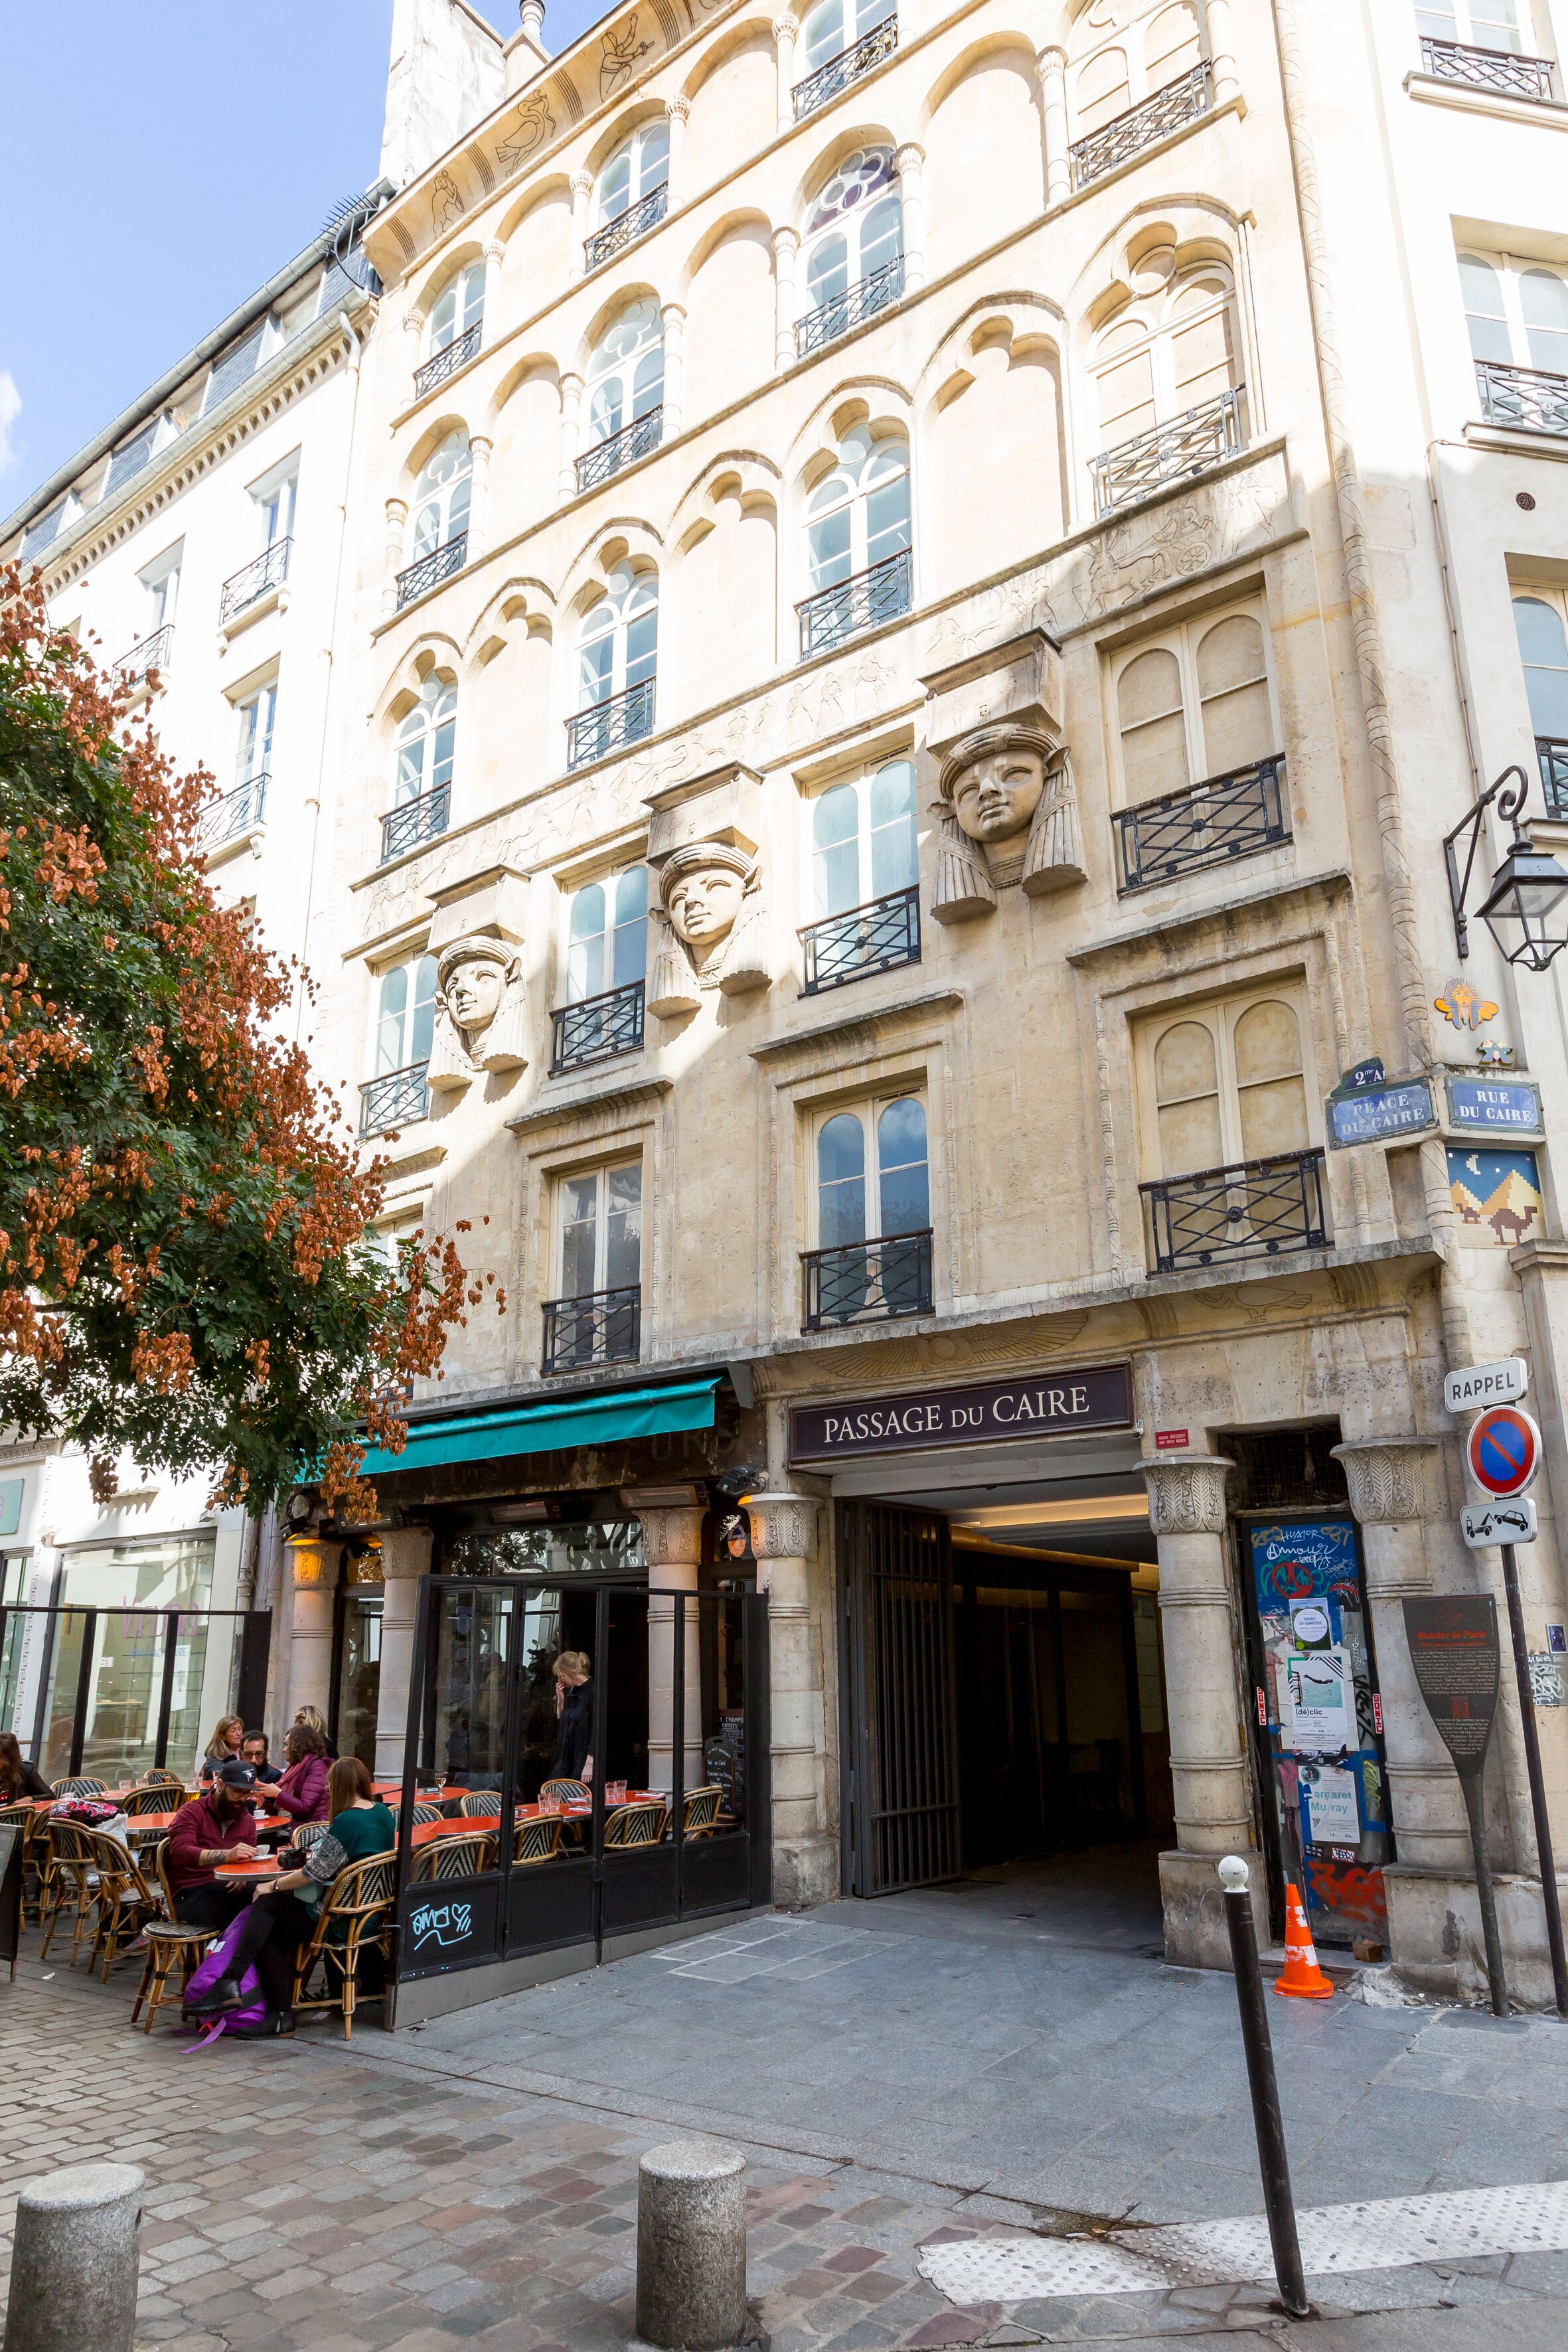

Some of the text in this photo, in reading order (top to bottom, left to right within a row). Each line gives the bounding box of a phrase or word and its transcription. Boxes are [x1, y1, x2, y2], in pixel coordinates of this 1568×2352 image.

[1353, 1094, 1409, 1117] PLACE
[1476, 1090, 1509, 1104] RUE
[1342, 1108, 1424, 1136] DU CAIRE
[1460, 1105, 1532, 1122] DU CAIRE
[1452, 1372, 1516, 1400] RAPPEL
[824, 1386, 1090, 1443] PASSAGE DU CAIRE
[1373, 1695, 1382, 1733] SONIC
[1314, 1791, 1352, 1801] argaret
[1311, 1802, 1348, 1814] Muray
